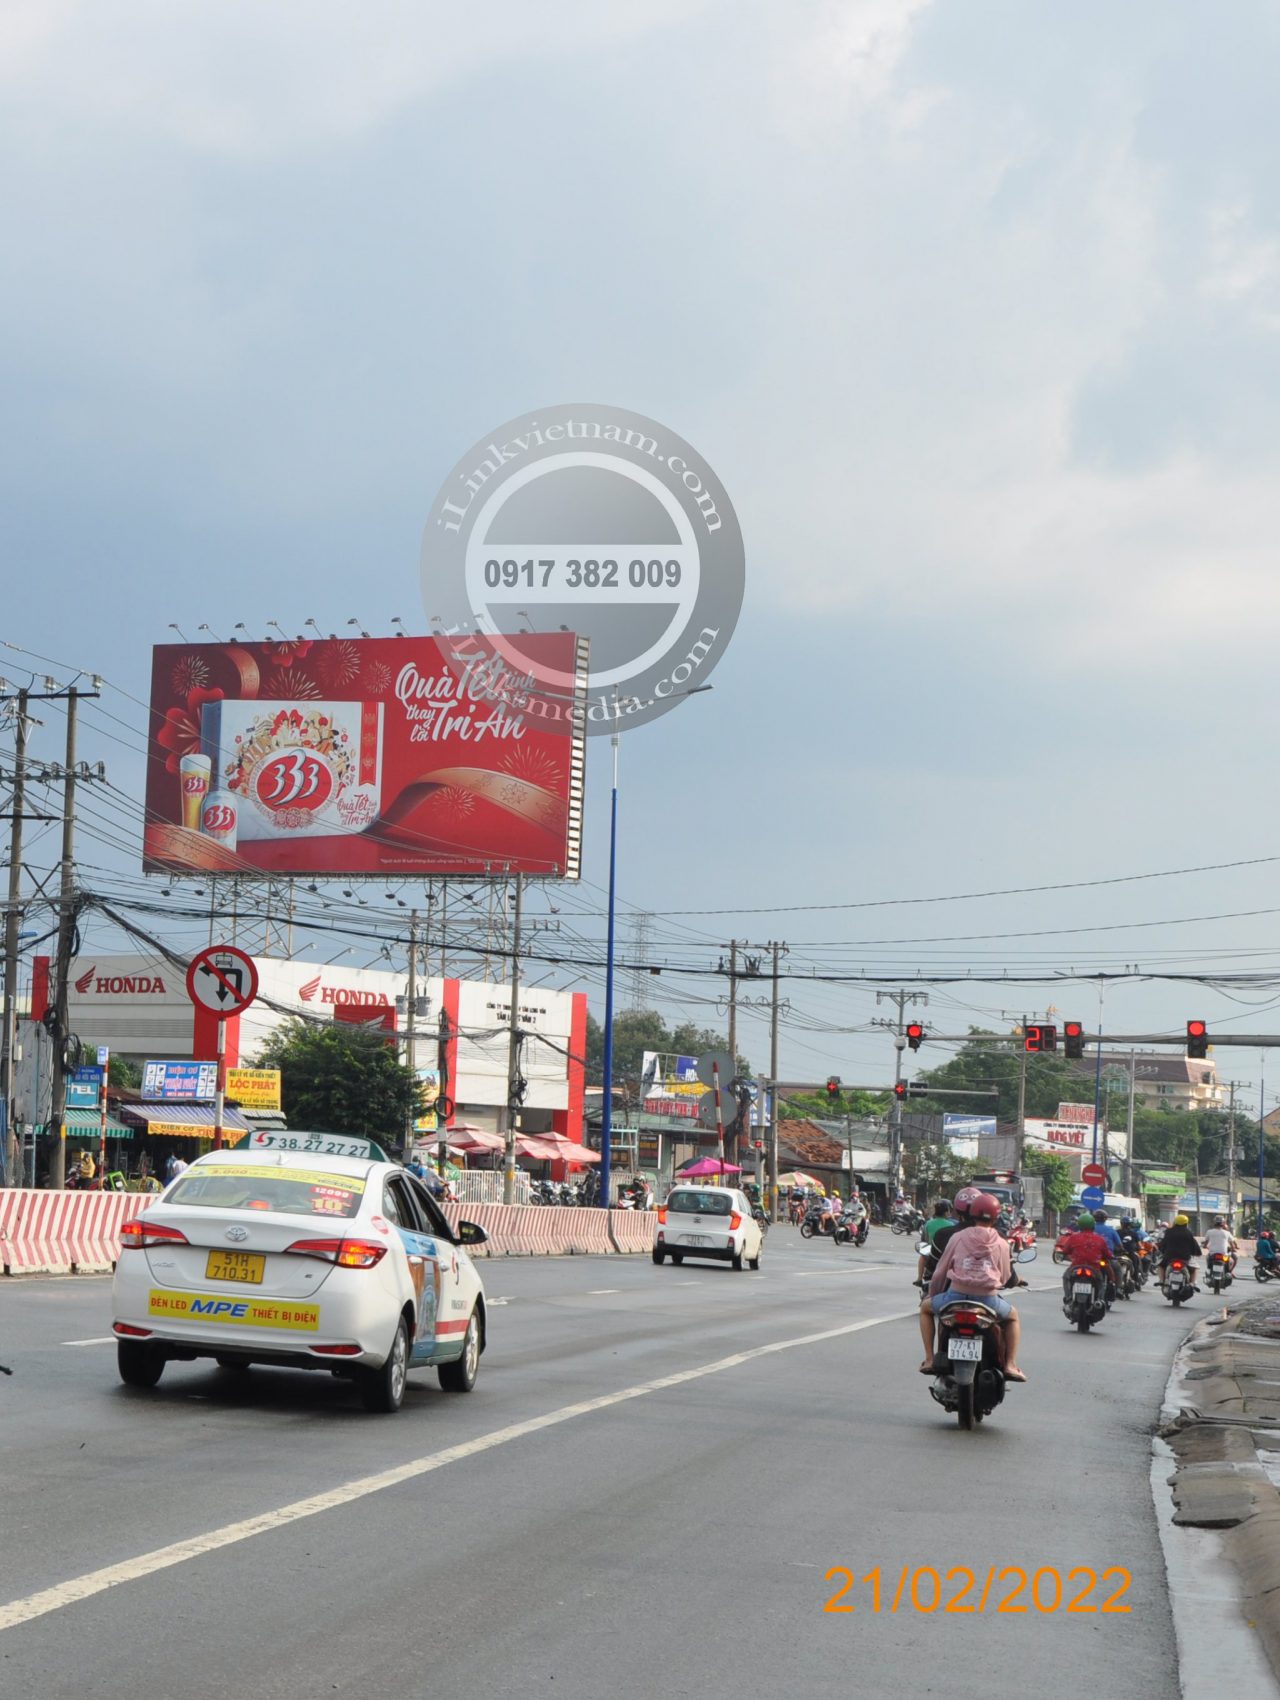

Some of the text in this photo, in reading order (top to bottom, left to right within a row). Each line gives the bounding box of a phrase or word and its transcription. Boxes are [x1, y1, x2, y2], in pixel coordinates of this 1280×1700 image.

[395, 662, 455, 710] Quà
[406, 704, 436, 728] thay
[428, 700, 473, 741] Tri
[266, 749, 320, 806] 333
[206, 805, 231, 828] 333
[96, 976, 166, 993] HONDA
[321, 987, 390, 1007] HONDA
[279, 1138, 368, 1157] 38.27 27 27
[225, 1254, 249, 1267] 51H
[213, 1265, 256, 1281] 710.31
[170, 1299, 187, 1310] LED
[190, 1300, 249, 1317] MPE
[252, 1306, 279, 1320] THIẾT
[282, 1311, 292, 1324] BỊ
[294, 1310, 317, 1324] ĐIỆN
